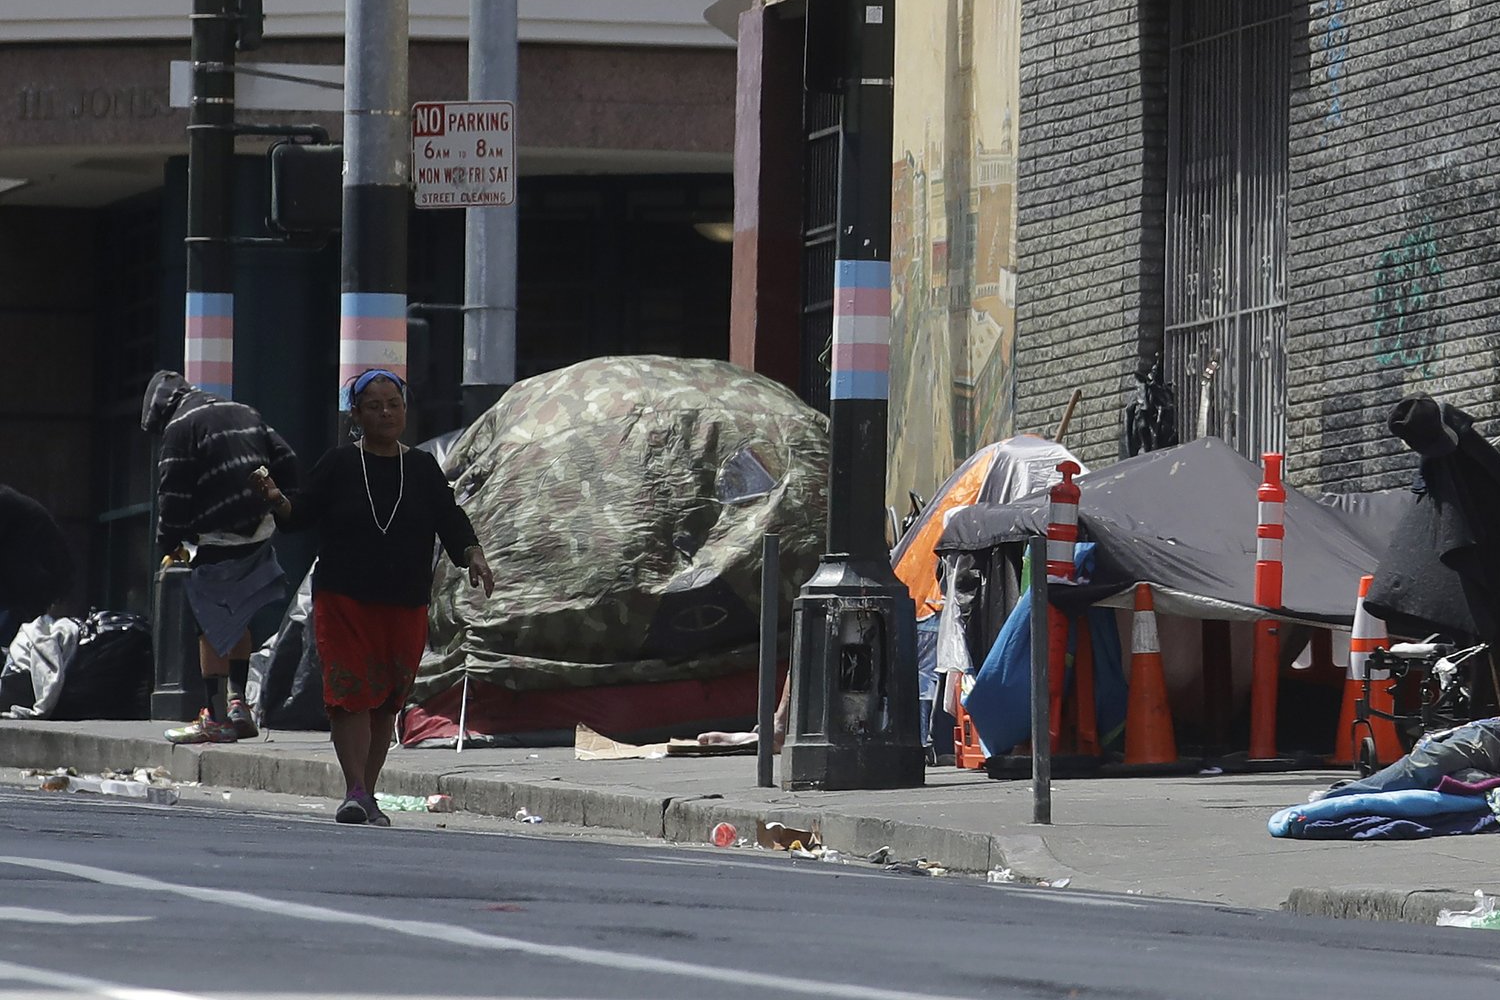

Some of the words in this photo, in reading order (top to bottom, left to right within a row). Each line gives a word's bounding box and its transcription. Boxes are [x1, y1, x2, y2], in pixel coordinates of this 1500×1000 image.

[416, 106, 441, 133] NO
[448, 112, 509, 132] PARKING
[419, 167, 440, 184] MON
[468, 167, 485, 183] FRI
[489, 166, 509, 183] SAT
[422, 192, 455, 203] STREET
[461, 191, 506, 203] CLEANING
